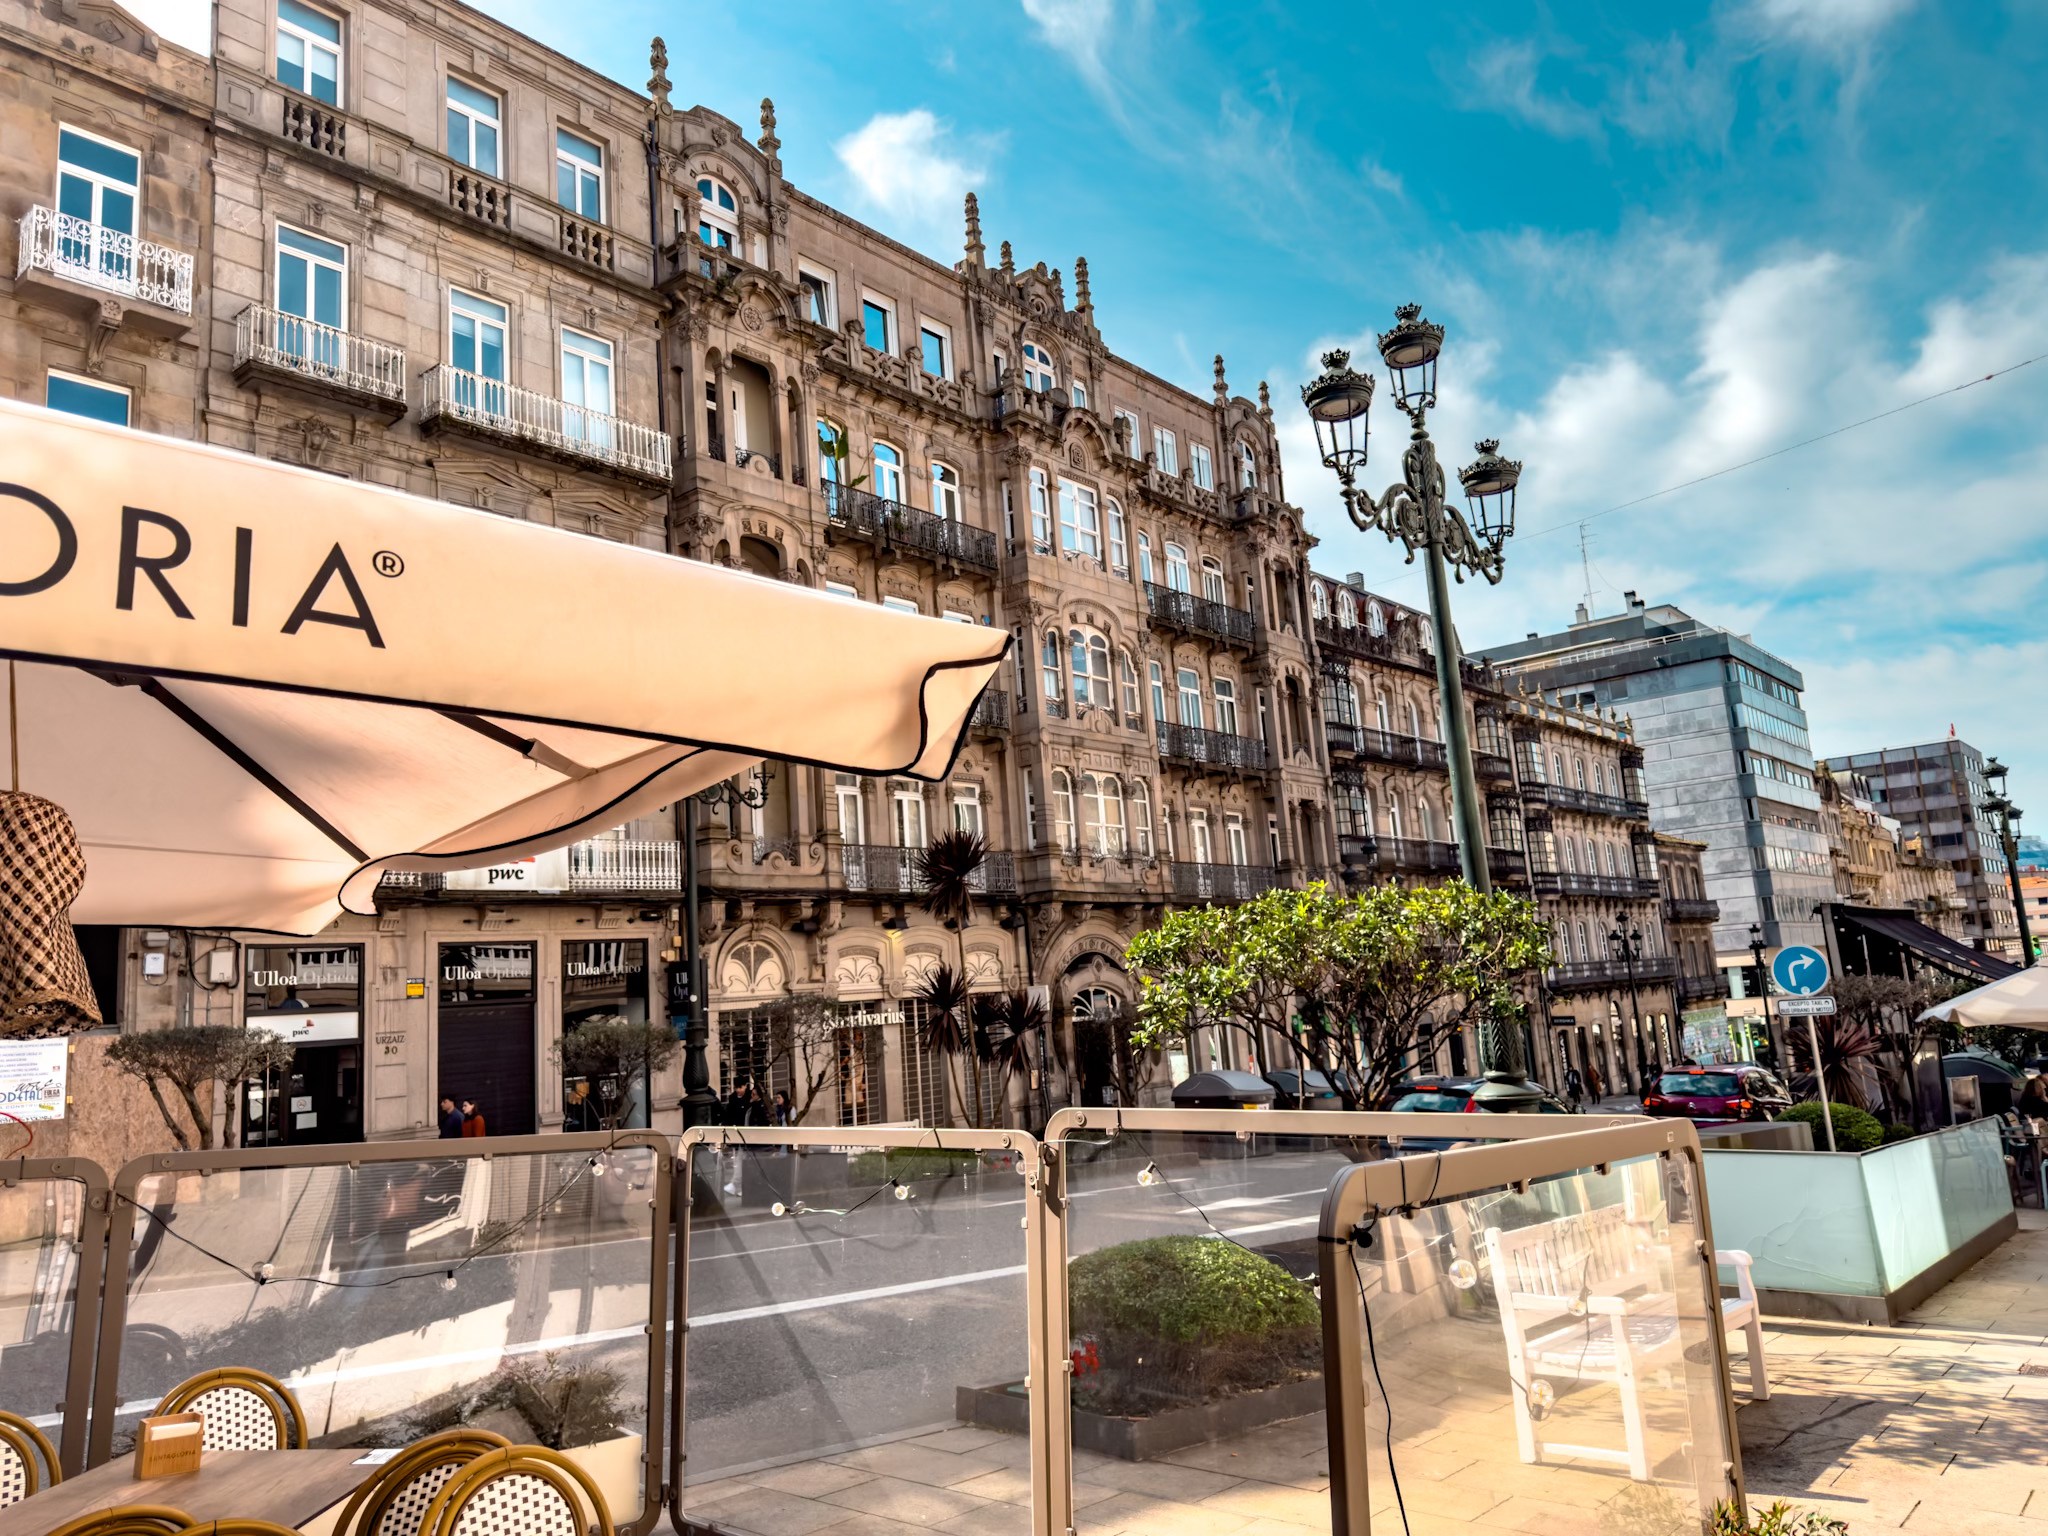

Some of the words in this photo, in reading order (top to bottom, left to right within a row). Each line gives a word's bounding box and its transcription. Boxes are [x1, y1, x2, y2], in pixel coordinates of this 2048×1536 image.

[488, 868, 524, 884] pwc
[444, 965, 482, 981] Ulloa
[567, 962, 600, 977] Ulloa
[253, 970, 298, 987] Ulloa
[676, 972, 689, 984] Ull
[375, 1035, 405, 1045] URZAIZ
[384, 1046, 398, 1055] 30
